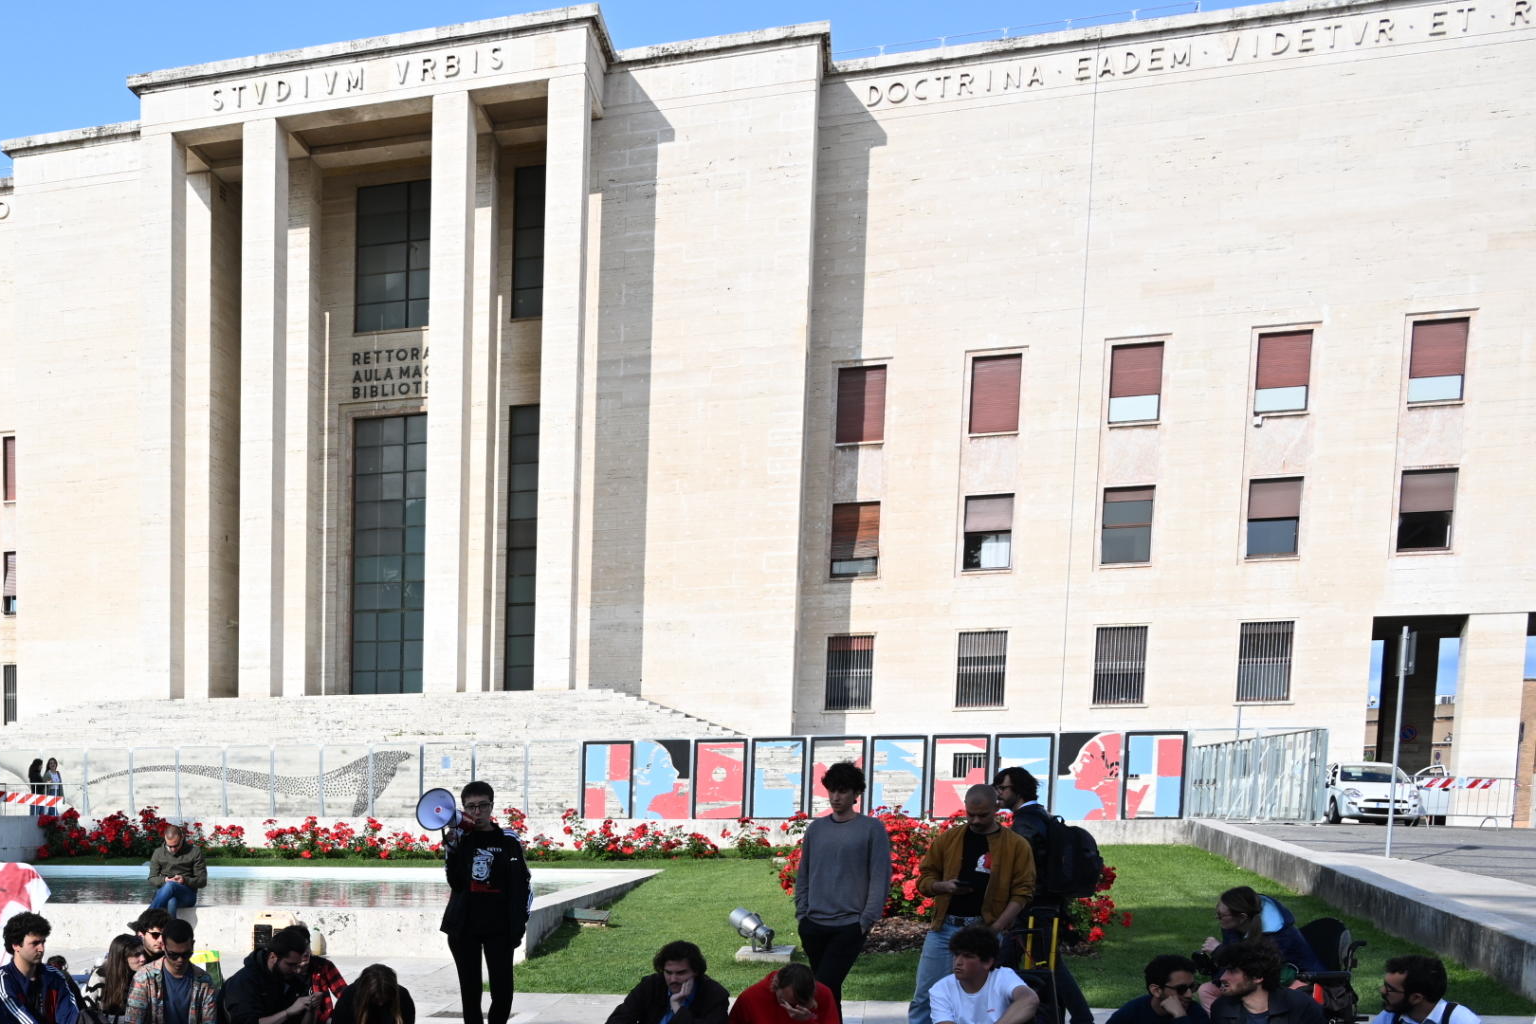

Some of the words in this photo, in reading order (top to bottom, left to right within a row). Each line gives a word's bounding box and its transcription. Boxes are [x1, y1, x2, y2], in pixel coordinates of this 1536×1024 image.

[210, 66, 364, 112] STVDIVM
[395, 47, 505, 85] VRBIS
[866, 64, 1044, 108] DOCTRINA
[1074, 43, 1192, 81] EADEM
[1226, 18, 1395, 62] VIDETVR
[1428, 7, 1476, 37] ET
[352, 368, 394, 384] AULA
